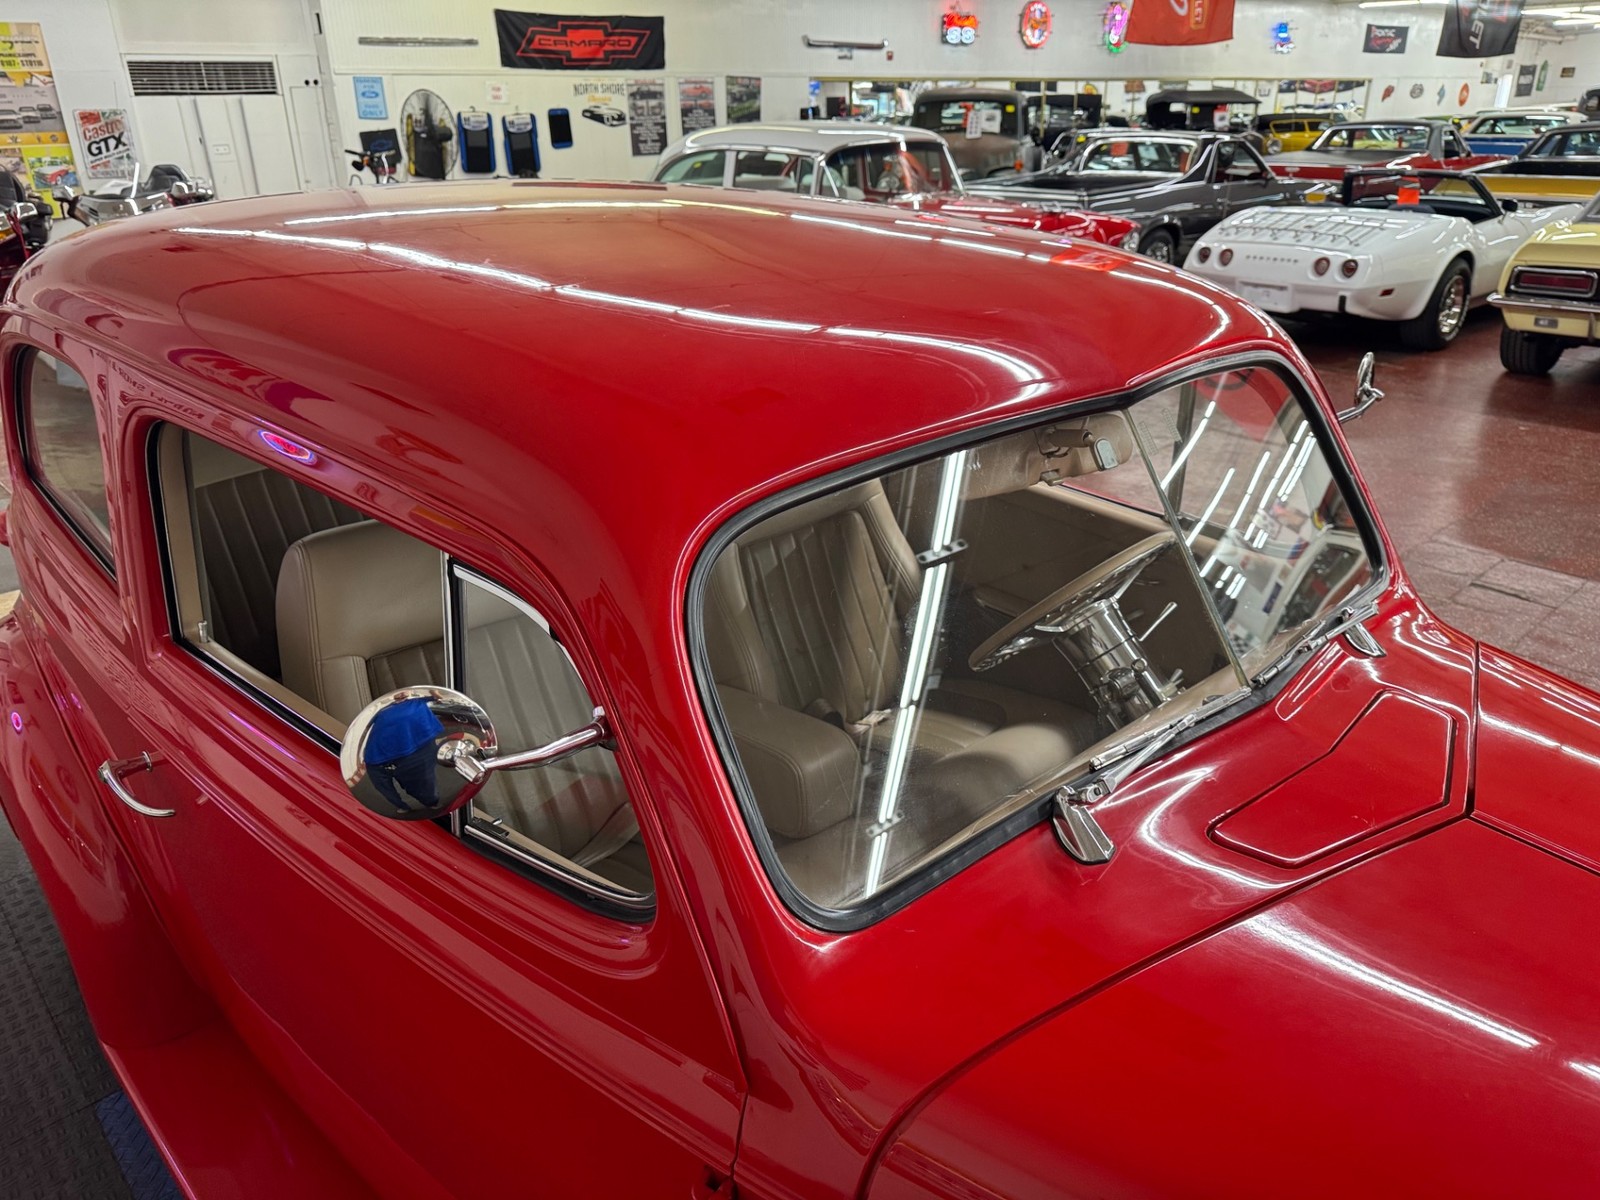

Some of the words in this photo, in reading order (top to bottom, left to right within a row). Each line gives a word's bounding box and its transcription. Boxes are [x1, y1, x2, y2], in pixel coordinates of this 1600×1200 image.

[537, 37, 632, 48] CAMARO
[574, 83, 599, 97] NORTH
[600, 83, 625, 96] SHORE
[87, 131, 128, 157] GTX
